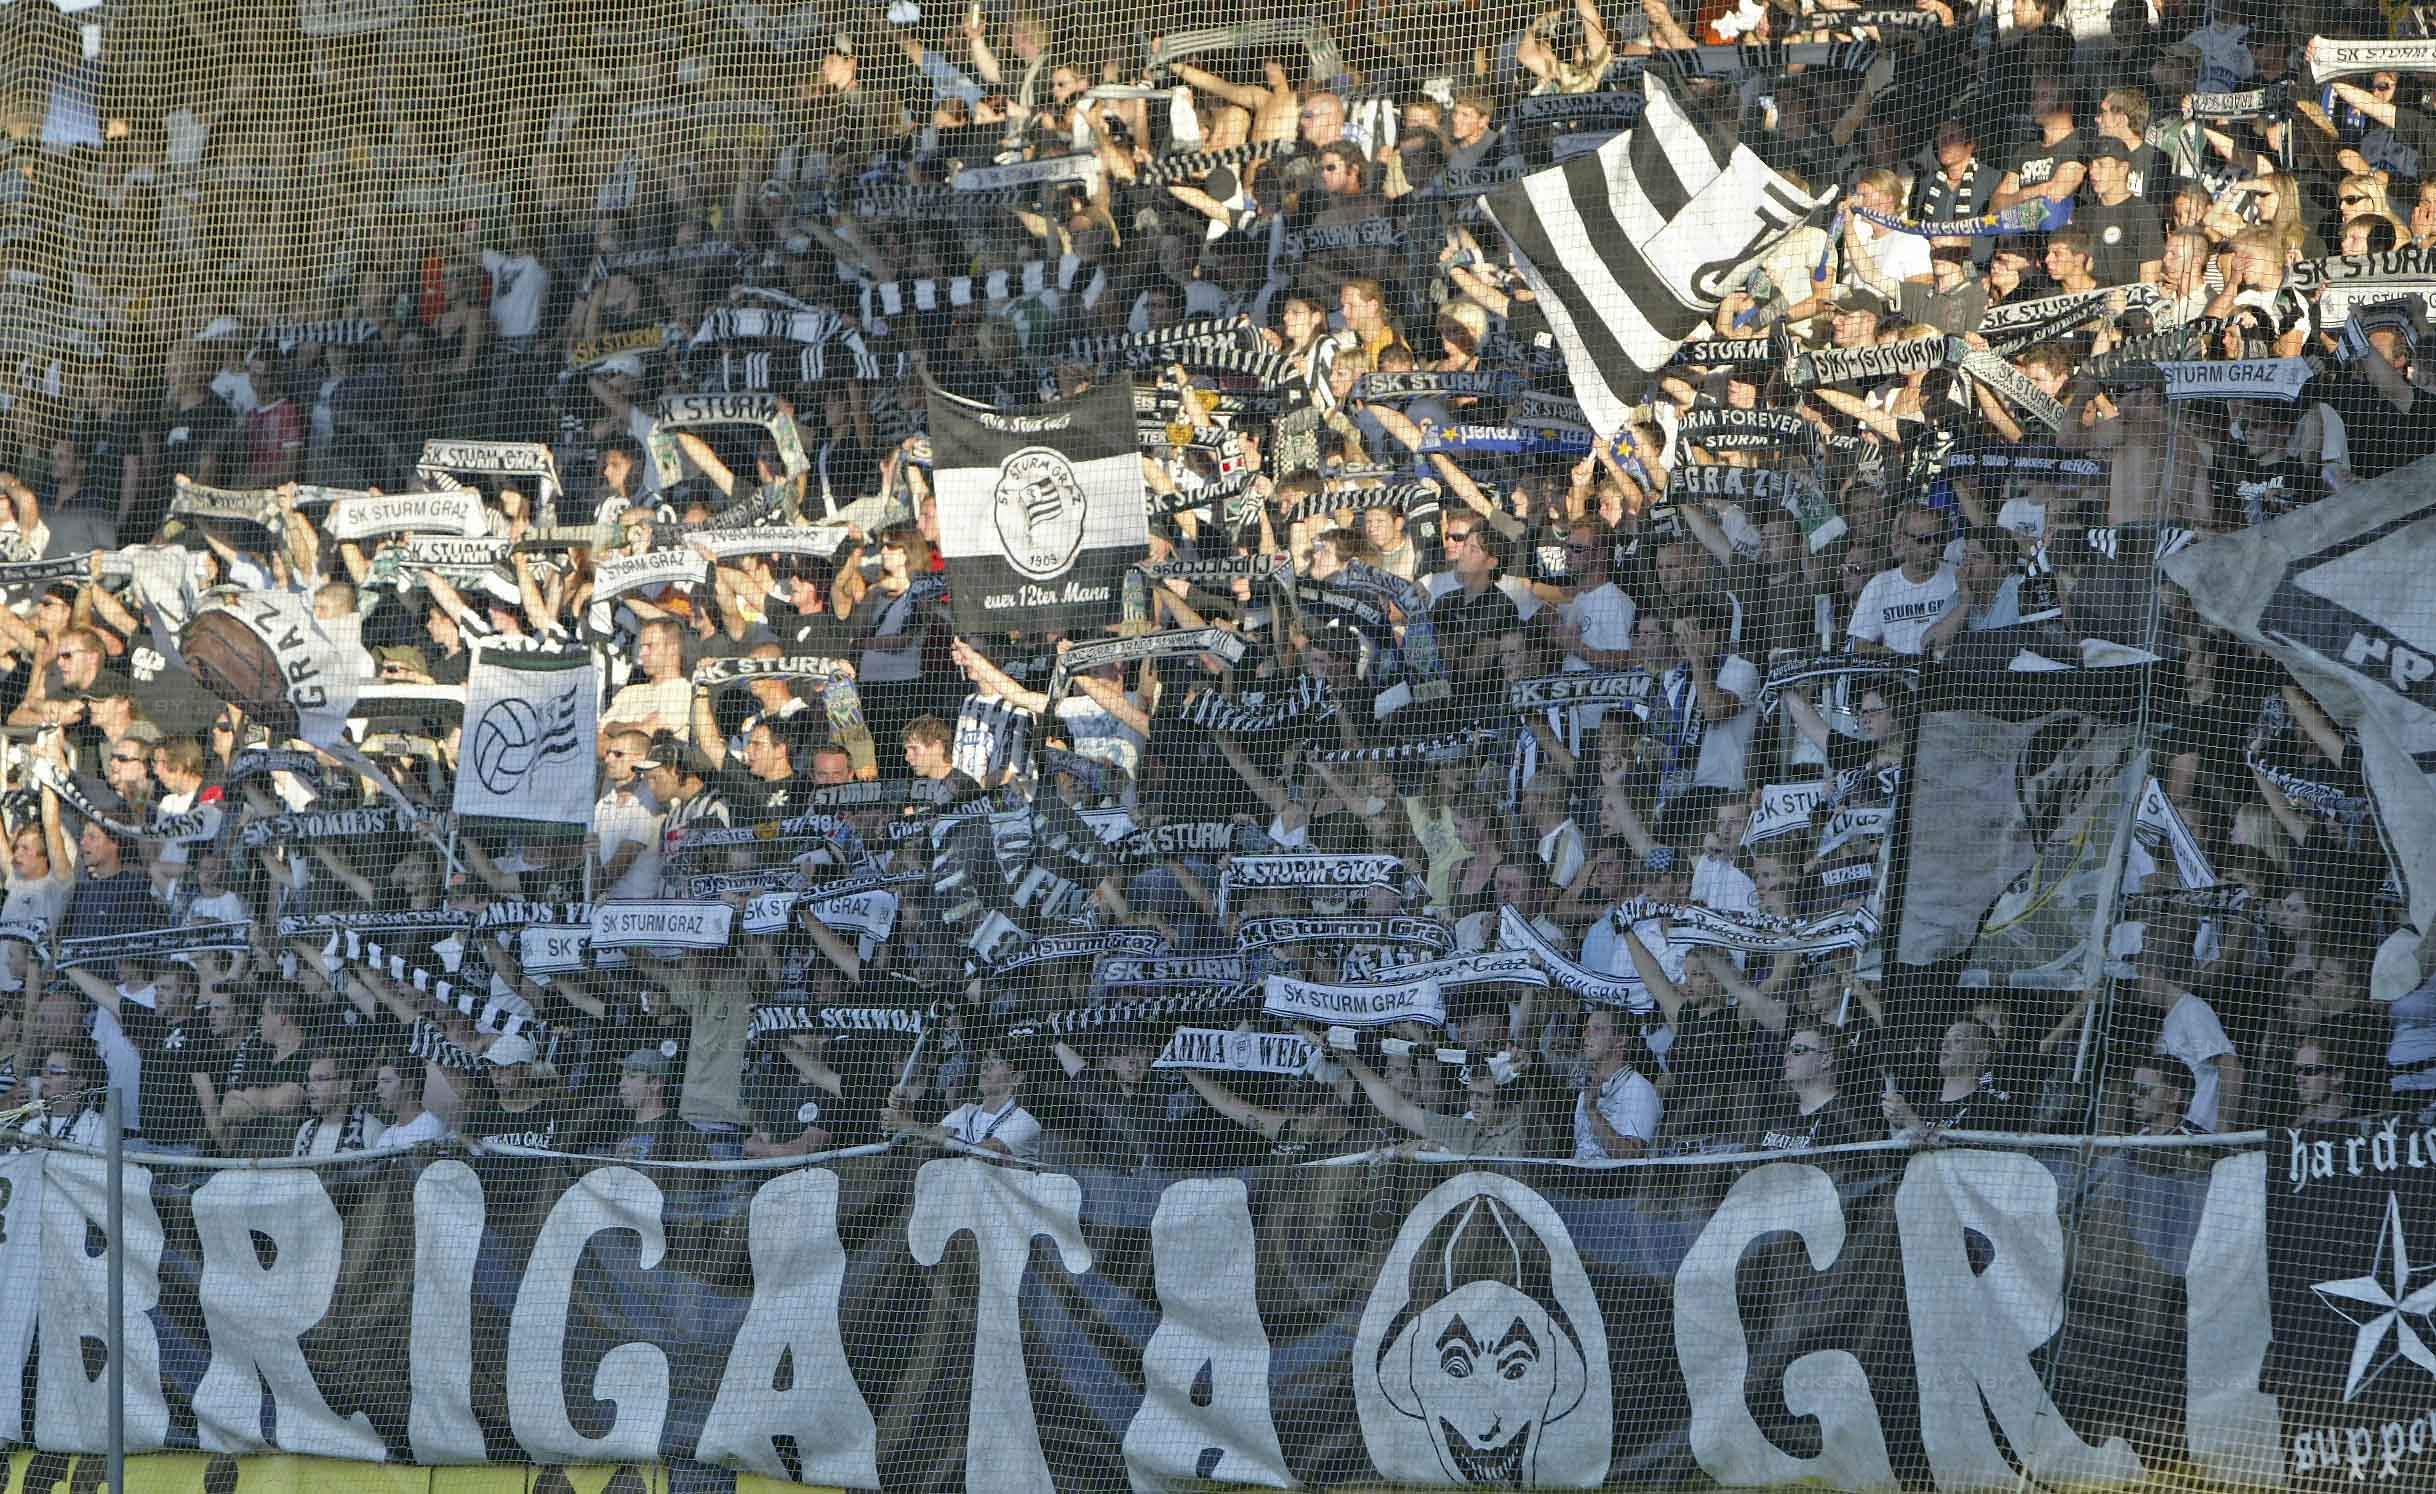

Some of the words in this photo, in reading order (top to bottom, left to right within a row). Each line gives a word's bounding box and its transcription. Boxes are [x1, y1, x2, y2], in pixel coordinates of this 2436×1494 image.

[2293, 257, 2329, 286] SK
[1983, 308, 2009, 331] SK
[1694, 341, 1769, 361] STURM
[1371, 374, 1401, 391] SK
[1411, 373, 1494, 391] STURM
[1999, 363, 2015, 385] SK
[2228, 363, 2278, 382] GRAZ
[1721, 409, 1802, 435] FOREVER
[1705, 434, 1769, 448] STURM
[448, 447, 498, 469] STURM
[1008, 456, 1049, 480] STURM
[1173, 478, 1242, 507] STURM
[1684, 466, 1771, 498] GRAZ
[348, 506, 369, 526] SK
[374, 501, 428, 521] STURM
[430, 500, 469, 520] GRAZ
[431, 542, 491, 563] STURM
[609, 554, 646, 580] STURM
[650, 552, 685, 571] GRAZ
[984, 593, 1015, 609] euer
[1018, 583, 1058, 607] 12ter
[1061, 580, 1110, 604] Mann
[1882, 603, 1925, 621] STURM
[254, 599, 328, 709] GRAZ
[738, 656, 832, 676] STURM
[1552, 677, 1651, 700] STURM
[1128, 830, 1156, 856] SK
[1158, 821, 1233, 851] STURM
[1254, 861, 1328, 883] STURM
[1332, 855, 1395, 882] GRAZ
[744, 899, 767, 921] SK
[830, 896, 872, 917] GRAZ
[602, 914, 617, 934] SK
[621, 913, 666, 934] STURM
[668, 914, 704, 935] GRAZ
[547, 937, 571, 958] SK
[1104, 963, 1143, 980] SK
[1153, 958, 1241, 980] STURM
[1284, 983, 1307, 1005] SK
[1310, 990, 1368, 1014] STURM
[1372, 987, 1420, 1013] GRAZ
[36, 1153, 1300, 1494] BRIGATA
